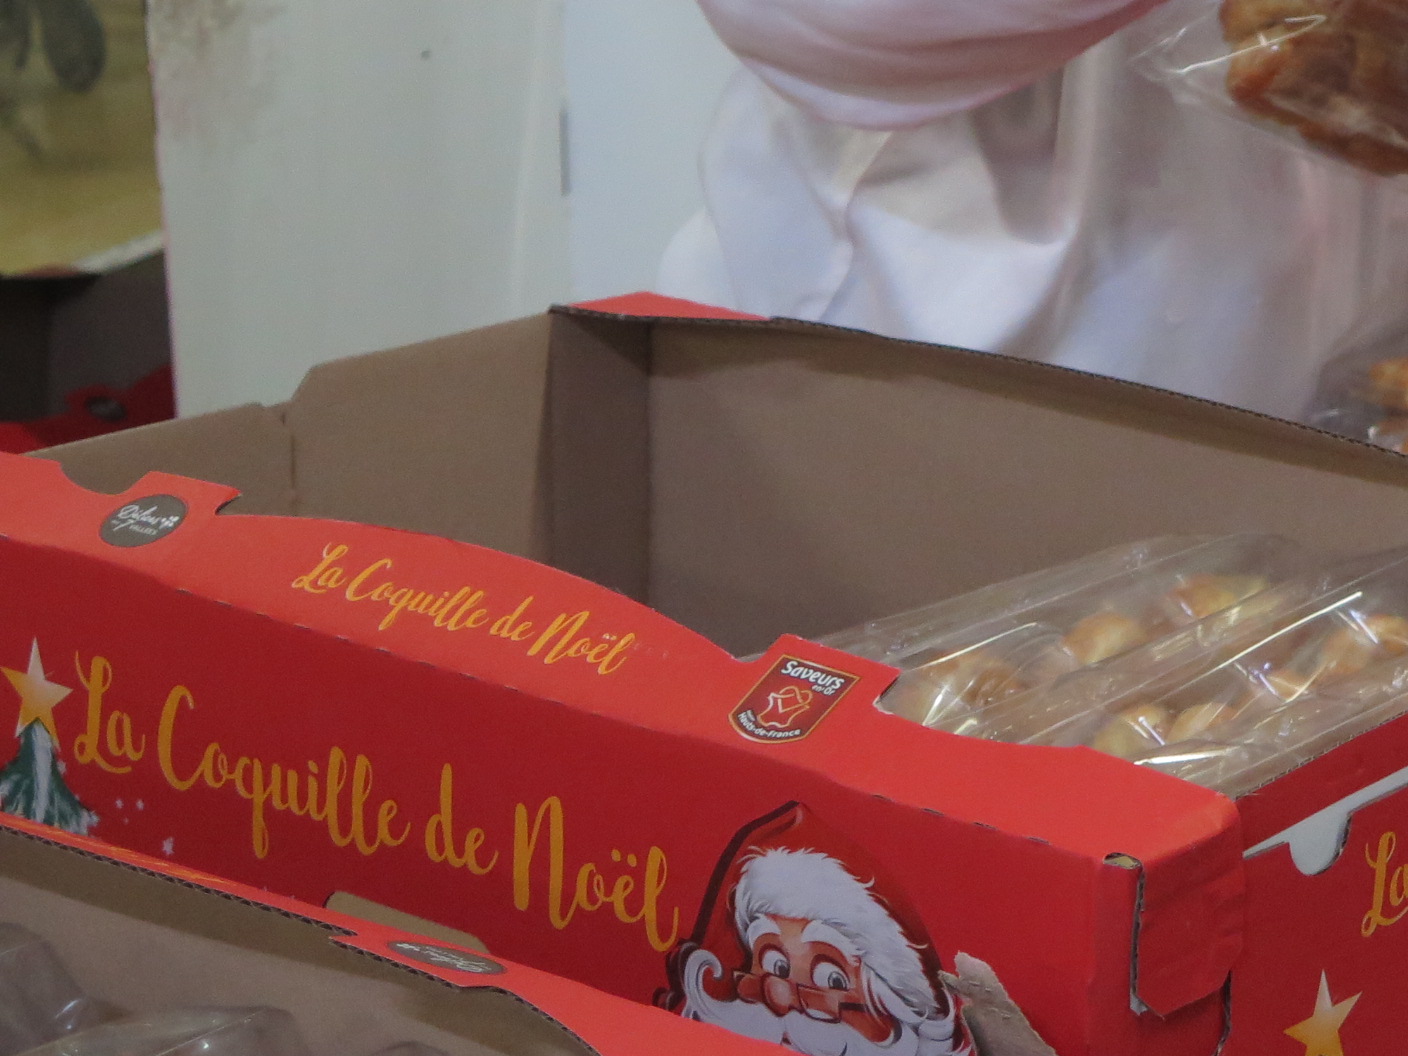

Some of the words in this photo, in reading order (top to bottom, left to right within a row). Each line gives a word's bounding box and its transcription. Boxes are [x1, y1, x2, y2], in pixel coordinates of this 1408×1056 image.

[291, 542, 348, 594] La
[345, 557, 489, 631] Coquille
[489, 595, 536, 642] de
[526, 610, 636, 676] Noël
[780, 660, 845, 690] Saveurs
[737, 711, 801, 739] Hauts-de-France
[73, 650, 146, 774] La
[157, 684, 411, 859] Coquille
[425, 762, 499, 875] de
[513, 795, 679, 952] Noël
